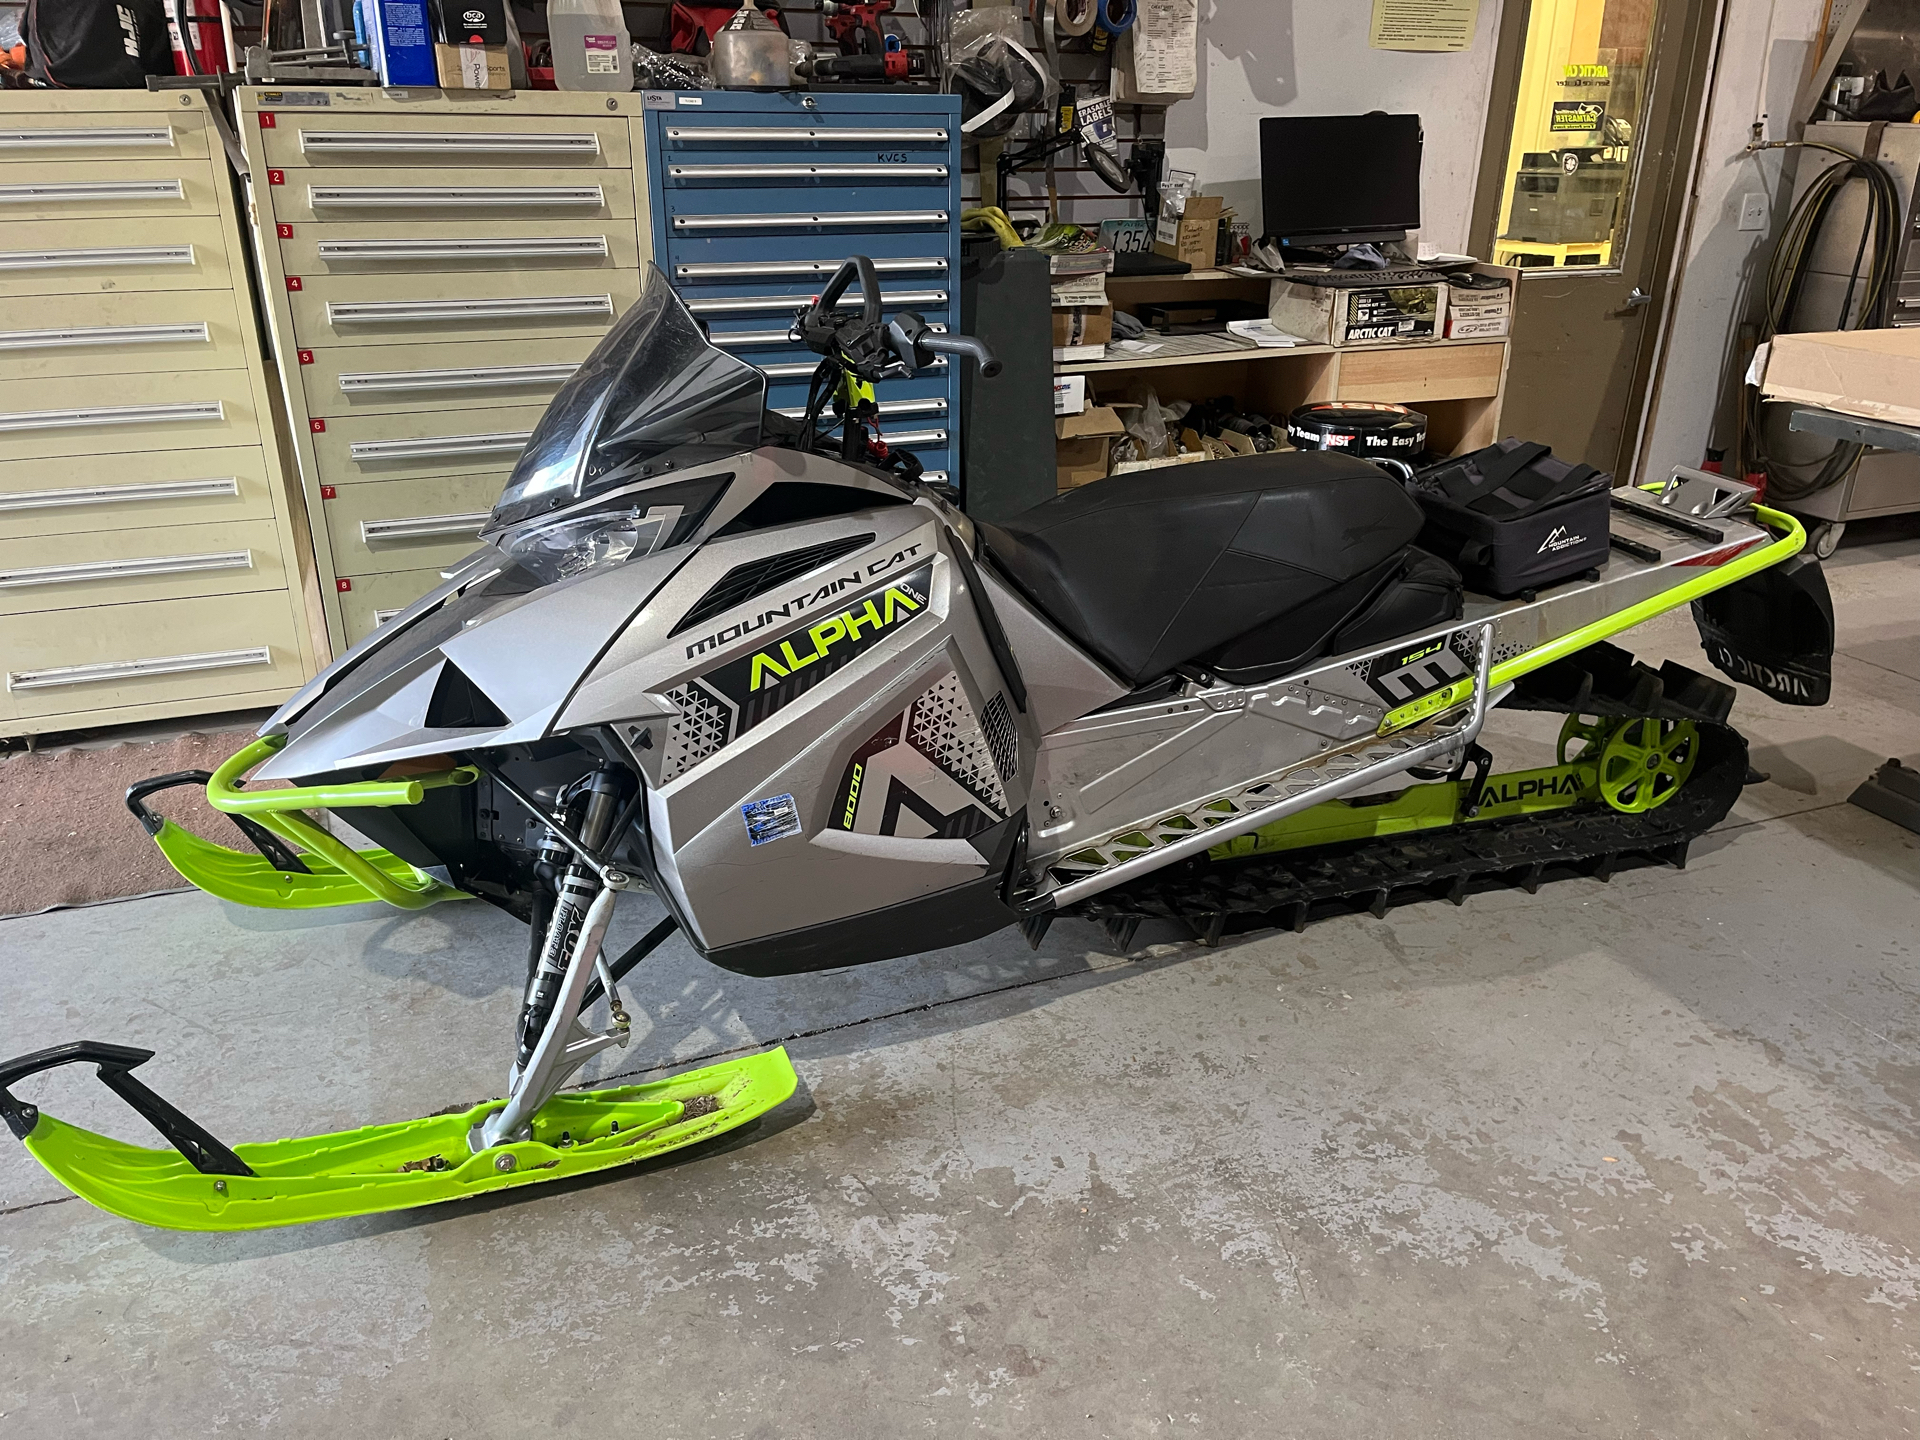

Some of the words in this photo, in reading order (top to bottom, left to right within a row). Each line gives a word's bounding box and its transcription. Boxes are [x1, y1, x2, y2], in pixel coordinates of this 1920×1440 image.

[465, 10, 483, 20] bca
[116, 4, 139, 57] HJC
[1078, 100, 1111, 118] ERASABLE
[265, 115, 270, 125] 1
[1080, 107, 1113, 126] LABELS
[273, 172, 280, 182] 2
[282, 226, 289, 236] 3
[291, 279, 298, 288] 4
[1348, 328, 1377, 340] ARCTIC
[1377, 326, 1396, 337] CAT
[303, 353, 309, 361] 5
[315, 422, 320, 430] 6
[1296, 426, 1320, 442] Team
[1366, 435, 1388, 446] The
[1392, 436, 1415, 447] Easy
[325, 487, 331, 495] 7
[1549, 535, 1580, 548] MOUNTAIN
[685, 570, 862, 660] MOUNTAIN
[867, 543, 922, 577] CAT
[750, 587, 920, 692] ALPHA
[901, 583, 927, 605] ONE
[1401, 642, 1442, 665] 154
[843, 762, 863, 830] 8000
[1479, 774, 1580, 808] ALPHA
